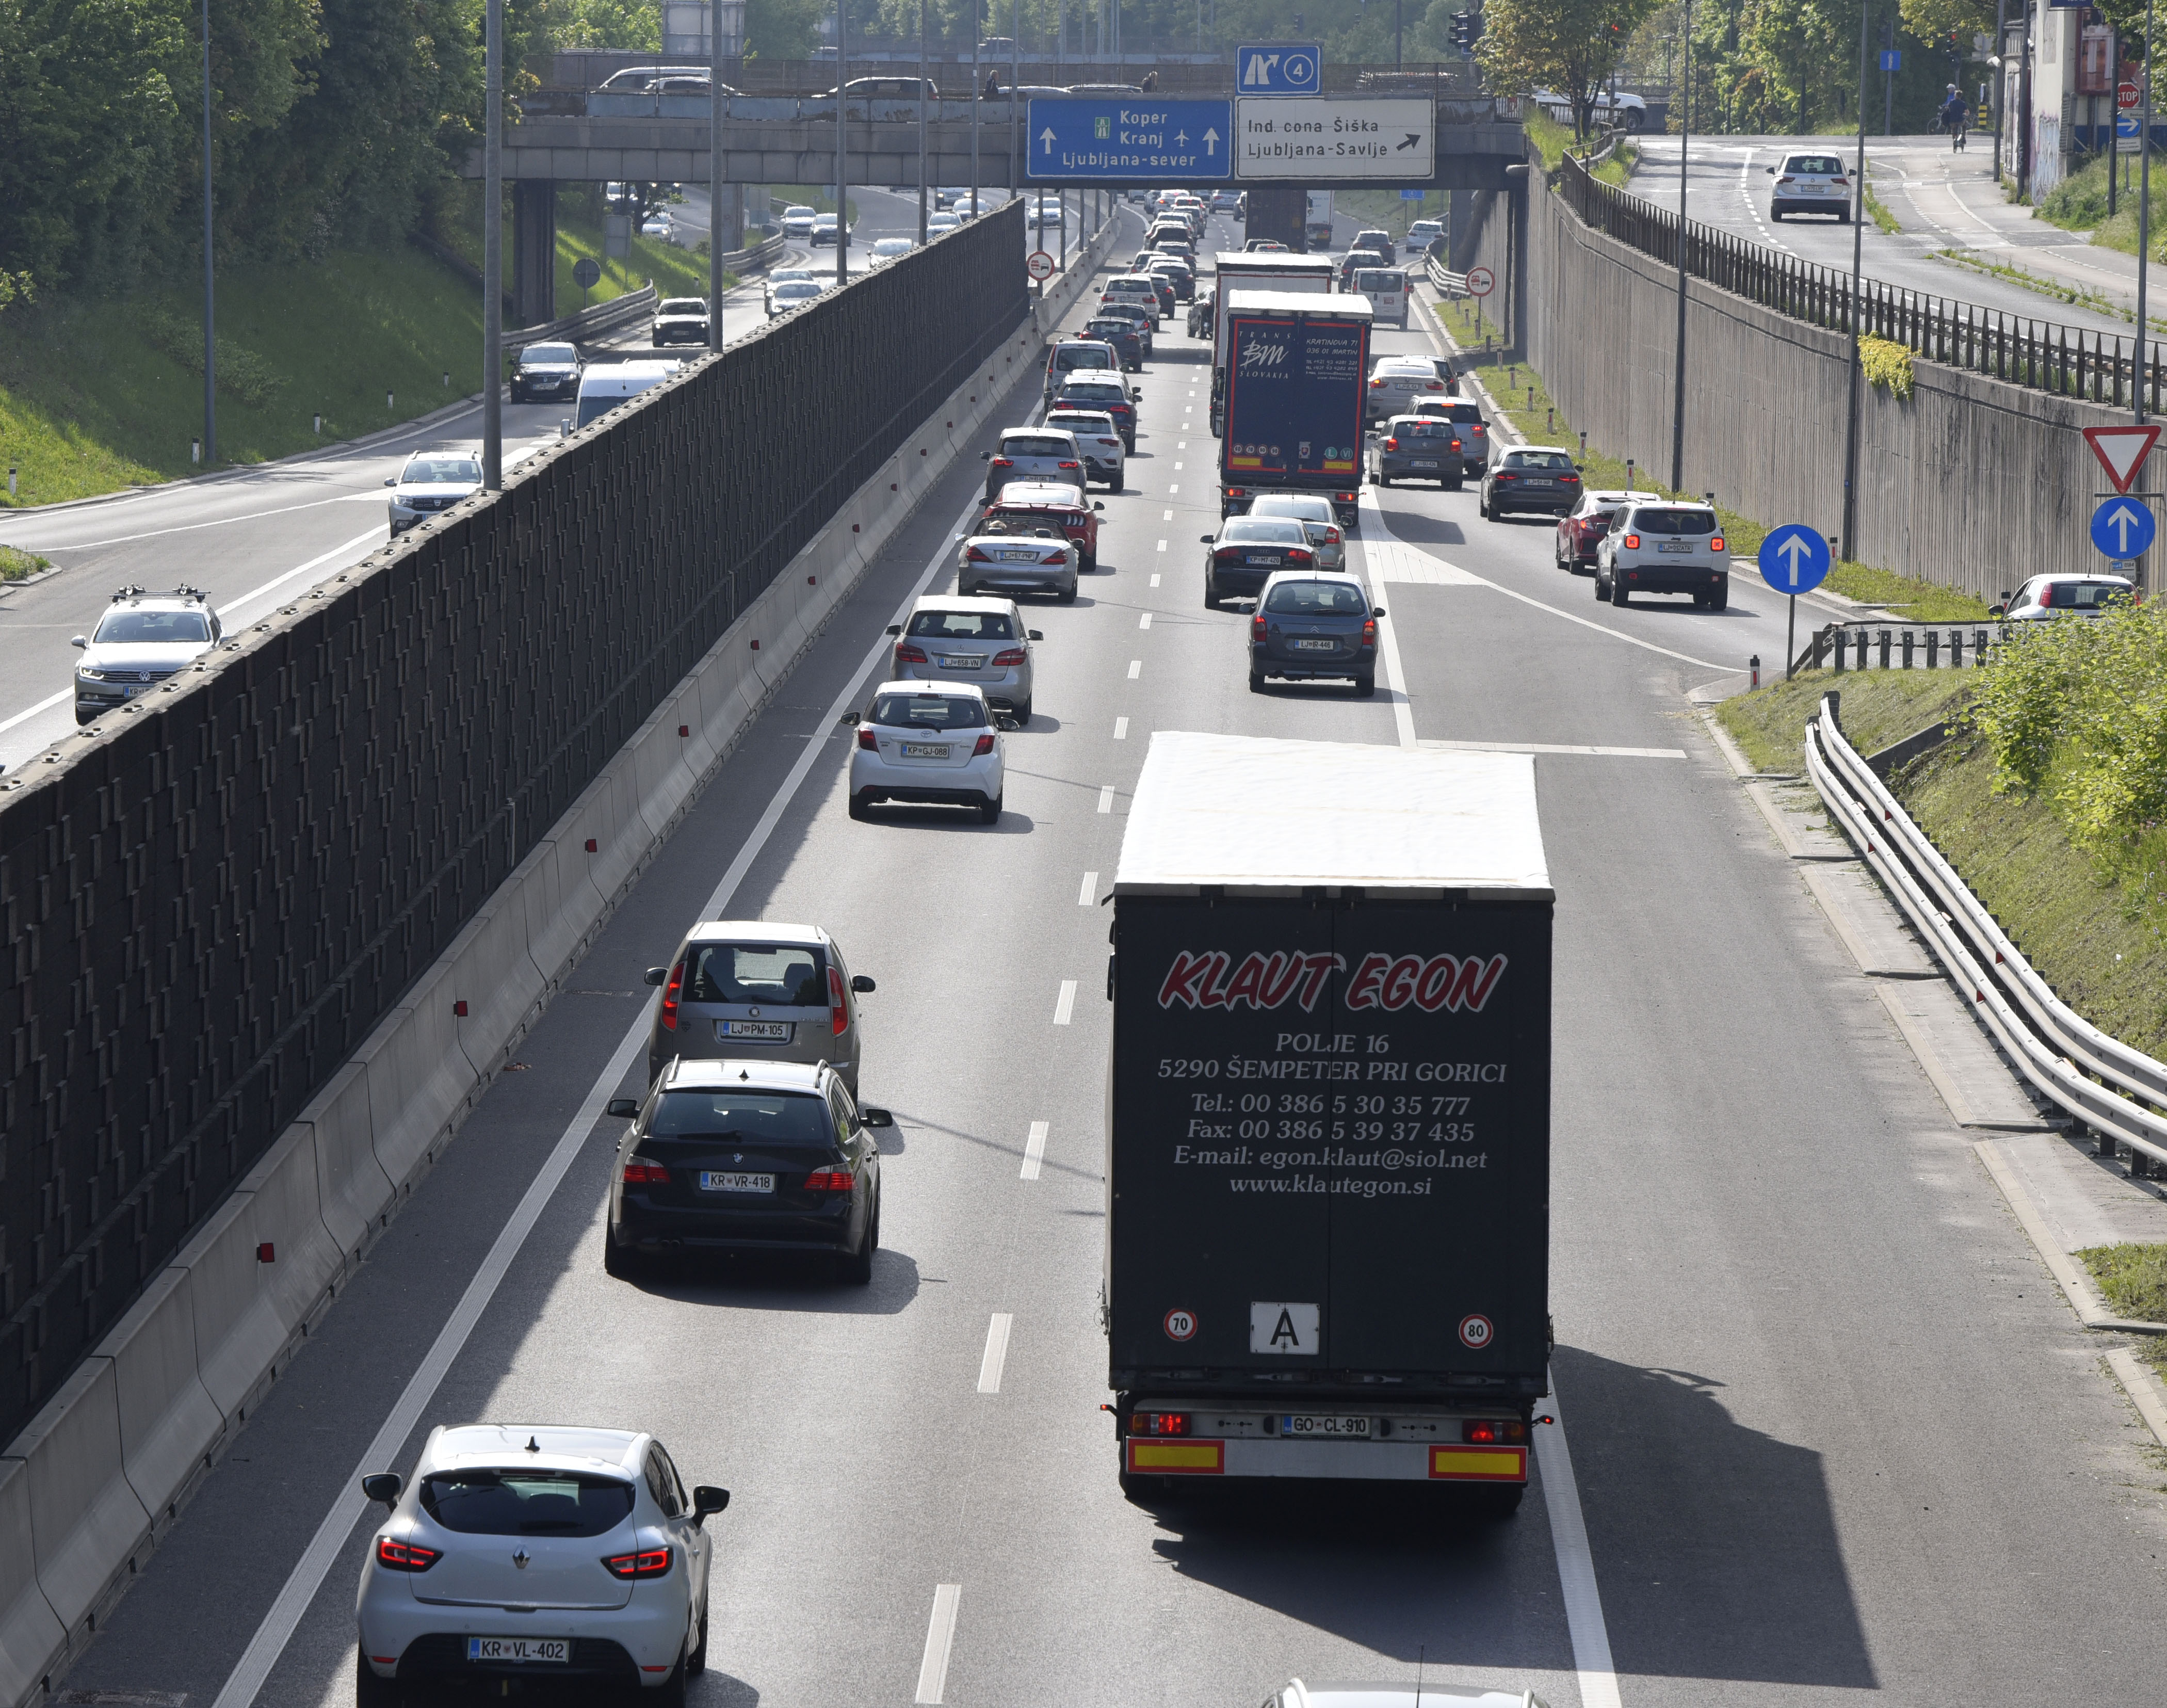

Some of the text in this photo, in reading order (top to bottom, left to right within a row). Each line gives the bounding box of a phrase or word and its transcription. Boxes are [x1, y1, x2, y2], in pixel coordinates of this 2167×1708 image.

[1293, 63, 1303, 77] 4
[1120, 110, 1168, 127] Koper
[1248, 116, 1379, 133] Ind. cona Šiška
[1120, 131, 1163, 149] Kranj
[1248, 142, 1387, 159] Ljubljana-Savlje
[1063, 152, 1196, 169] Ljubljana-sever
[1239, 331, 1291, 339] TRANS
[1239, 370, 1288, 379] SLOVAKIA
[1328, 448, 1334, 457] L
[957, 659, 979, 667] 658-VN
[130, 688, 138, 697] KR
[908, 746, 947, 756] KP GJ-088
[1158, 950, 1508, 1013] KLAUT EGON
[731, 1022, 783, 1036] LJ PM-105
[1275, 1033, 1390, 1053] POLJE 16
[1158, 1055, 1507, 1083] 5290 ŠEMPETER PRI GORICI
[1191, 1093, 1470, 1116] Tel.: 00 386 5 30 35 777
[1188, 1120, 1474, 1141] Fax: 00 386 5 39 37 435
[1174, 1146, 1488, 1170] E-mail: egon.klaut@siol.net
[711, 1174, 770, 1188] KR VR-418
[1231, 1174, 1431, 1198] www.klautegon.si
[1173, 1317, 1188, 1331] 70
[1269, 1309, 1299, 1346] A
[1468, 1323, 1484, 1338] 80
[1294, 1417, 1366, 1433] GO CL-910
[482, 1641, 563, 1658] KR VL-402
